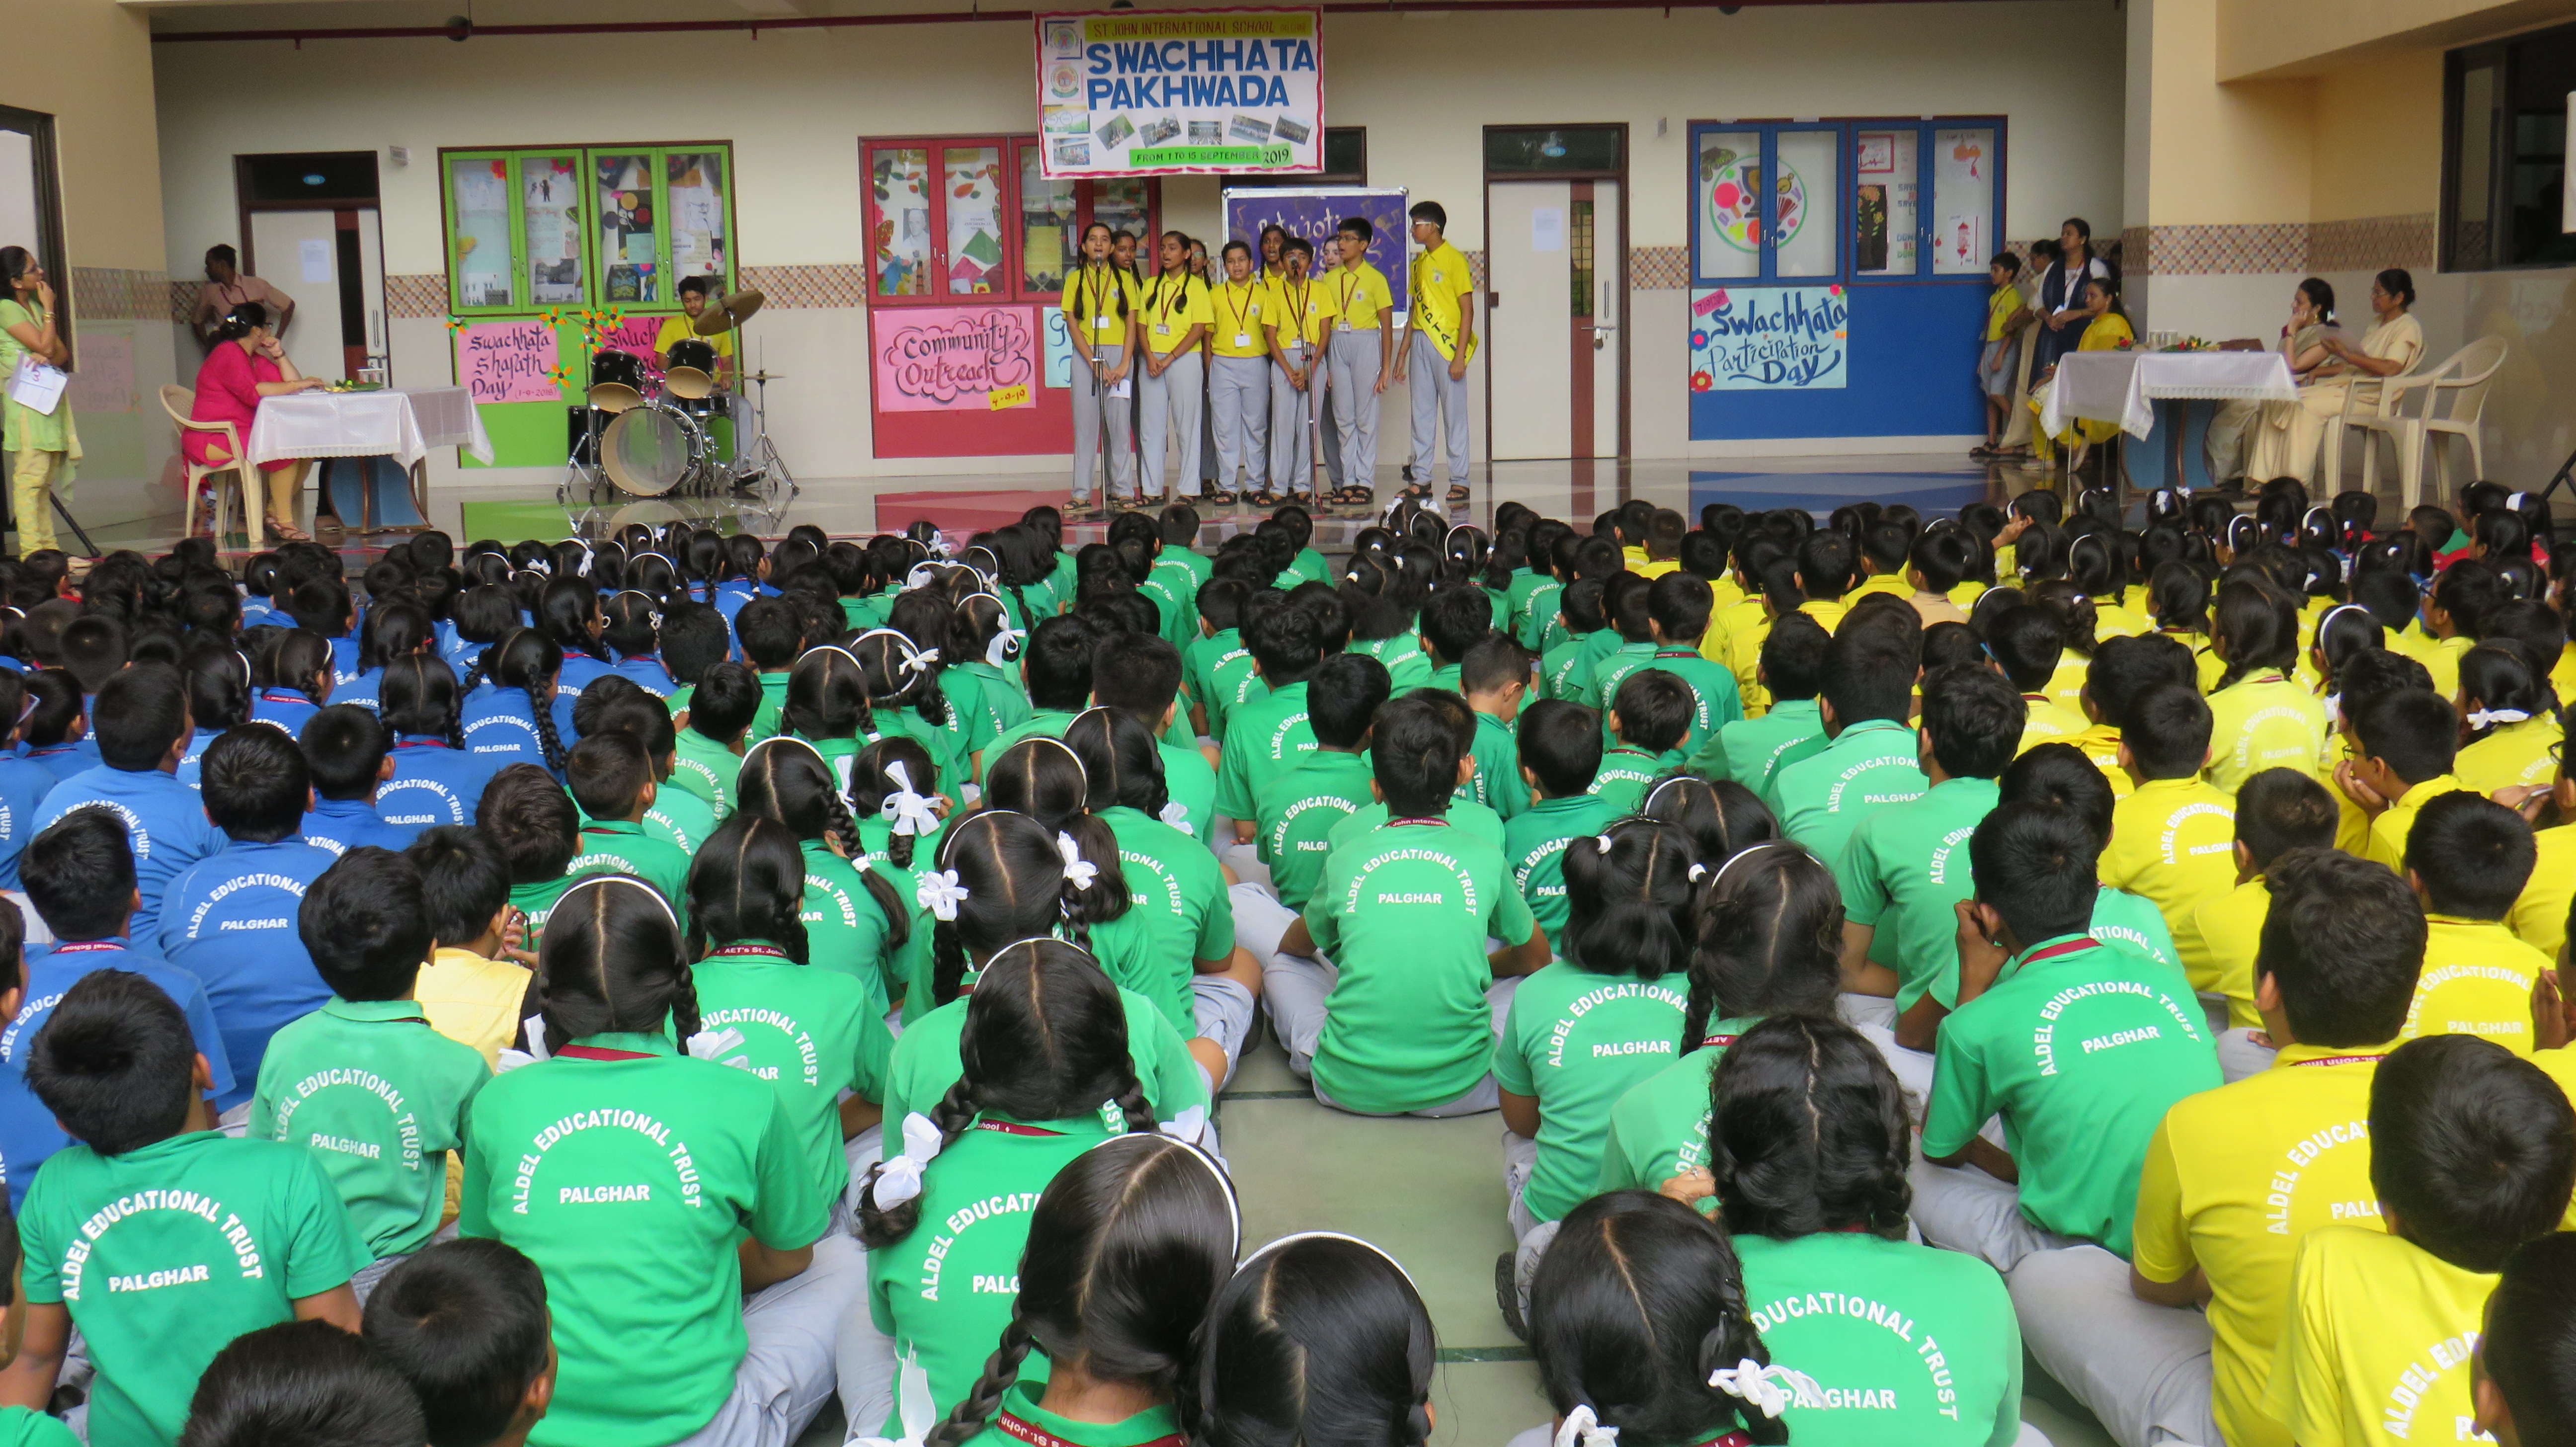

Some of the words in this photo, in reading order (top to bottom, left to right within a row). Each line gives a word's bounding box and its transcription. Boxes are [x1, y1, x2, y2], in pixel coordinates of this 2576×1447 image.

[1094, 24, 1108, 37] ST
[1112, 23, 1137, 37] JOHN
[1141, 20, 1227, 36] INTERNATIONAL
[1232, 20, 1275, 34] SCHOOL
[1086, 39, 1315, 75] SWACHHATA
[1087, 75, 1290, 111] PAKHWADA
[1201, 151, 1259, 161] SEPTEMBER
[1263, 149, 1289, 163] 2019
[1711, 291, 1848, 342] Swachhata
[904, 315, 1018, 364] Community
[905, 349, 1023, 390] Outreach
[472, 378, 512, 401] Day
[1530, 583, 1560, 597] EDUCATI
[1386, 650, 1418, 669] PALGHAR
[334, 670, 345, 686] TRU
[465, 715, 533, 734] EDUCATIONAL
[1695, 700, 1708, 730] TRUST
[474, 743, 521, 753] PALGHAR
[1270, 723, 1286, 760] ALDEL
[376, 778, 448, 801] EDUCATIONAL
[1598, 769, 1653, 788] EDUCATIO
[1828, 781, 1845, 813] ALDEL
[1840, 755, 1920, 782] EDUCATIONA
[384, 814, 435, 824] PALGHAR
[713, 787, 724, 819] TRUST
[1273, 820, 1290, 856] ALDEL
[1284, 795, 1357, 821] EDUCATIONA
[133, 828, 150, 860] TRUST
[2161, 830, 2175, 865] ALDEL
[2189, 842, 2236, 856] PALGHA
[1346, 874, 1366, 914] ALDEL
[1362, 848, 1458, 874] EDUCATIONAL
[1456, 869, 1477, 916] TRUST
[1931, 846, 1949, 885] ALDEL
[187, 900, 213, 939] ALDEL
[209, 873, 307, 903] EDUCATIONAL
[832, 888, 857, 928] TRUST
[1163, 874, 1182, 917] TRUST
[1378, 893, 1442, 905] PALGHAR
[1537, 885, 1567, 896] PALG
[220, 917, 288, 931] PALGHAR
[2419, 965, 2531, 991] EDUCATIONAL
[2040, 981, 2153, 1020] EDUCATIONAL
[2159, 994, 2200, 1043] TRUST
[2447, 1020, 2523, 1034] PALGHAR
[701, 1008, 797, 1036] DUCATIONAL
[795, 1031, 818, 1086] TRUST
[1547, 1017, 1575, 1068] ALDEL
[1593, 1040, 1671, 1058] PALGHAR
[2034, 1019, 2057, 1076] ALDEL
[2081, 1025, 2160, 1054] PALGHAR
[295, 1068, 404, 1114] EDUCATIONAL
[398, 1112, 420, 1171] TRUST
[1103, 1098, 1123, 1133] UST
[311, 1133, 381, 1159] PALGHAR
[513, 1153, 542, 1215] ALDEL
[533, 1109, 671, 1152] EDUCATIONAL
[669, 1142, 702, 1208] TRUST
[560, 1185, 650, 1205] PALGHAR
[2267, 1170, 2298, 1235] ALDEL
[62, 1239, 92, 1301] ALDEL
[81, 1190, 222, 1242] EDUCATIONAL
[219, 1213, 264, 1280] TRUST
[109, 1264, 210, 1293] PALGHAR
[920, 1237, 953, 1302] ALDEL
[1752, 1292, 1917, 1342] DUCATIONAL
[1919, 1336, 1958, 1421] TRUST
[2383, 1362, 2436, 1439] ALDEL
